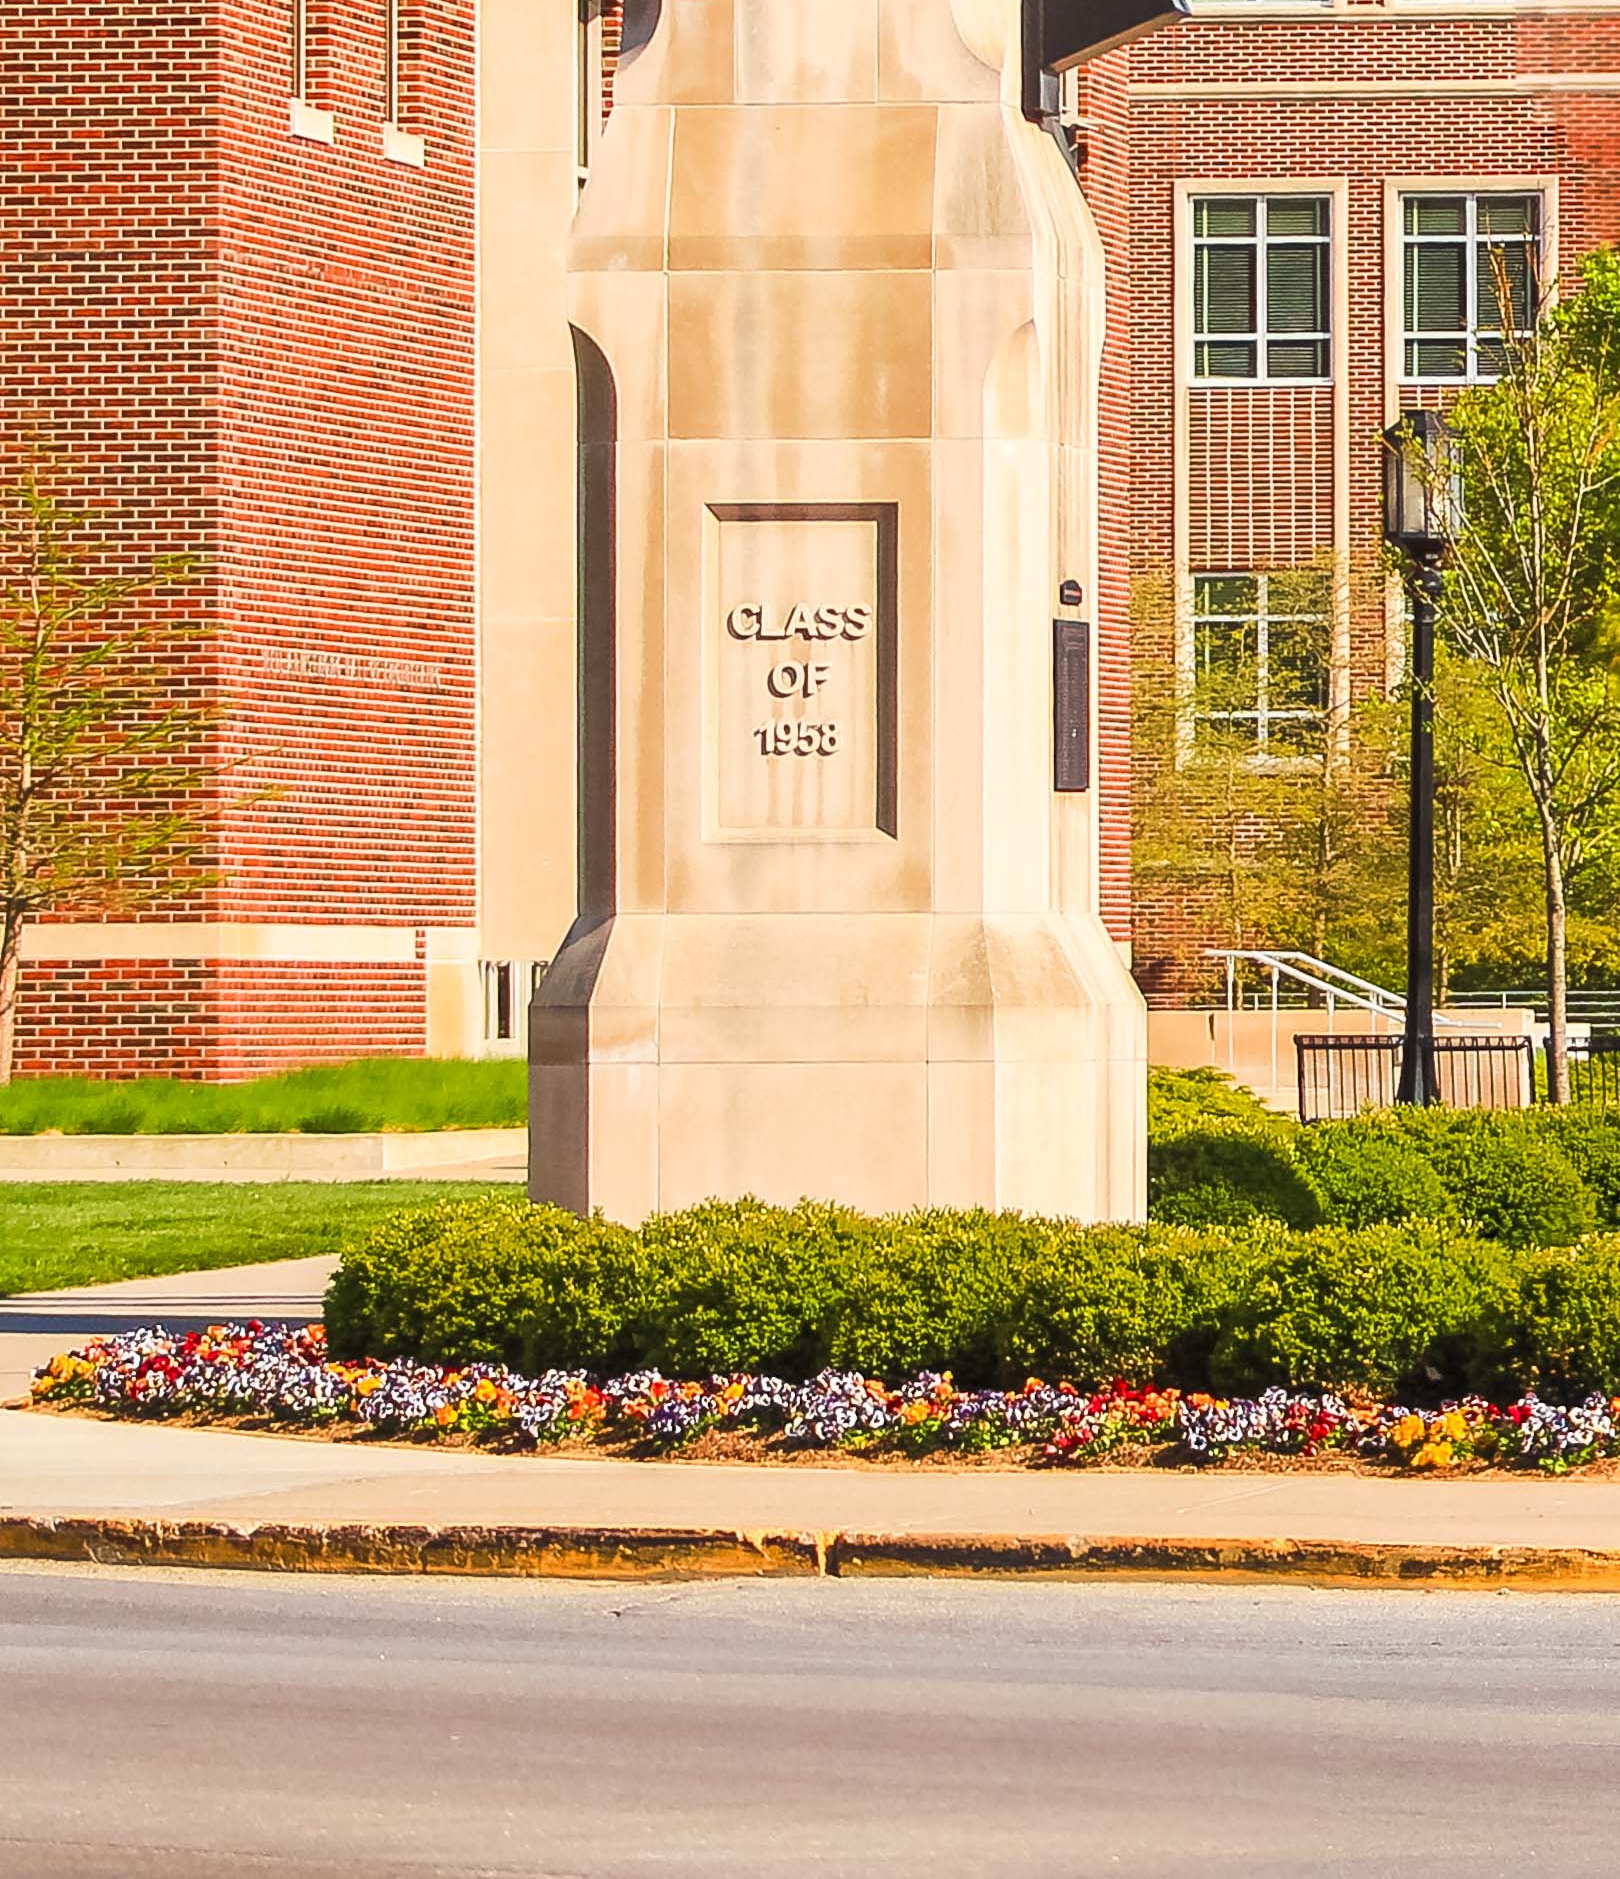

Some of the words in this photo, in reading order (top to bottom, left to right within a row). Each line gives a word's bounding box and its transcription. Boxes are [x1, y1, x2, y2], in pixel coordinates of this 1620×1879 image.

[727, 601, 873, 641] CLASS
[767, 660, 832, 698] OF
[753, 719, 843, 756] 1958
